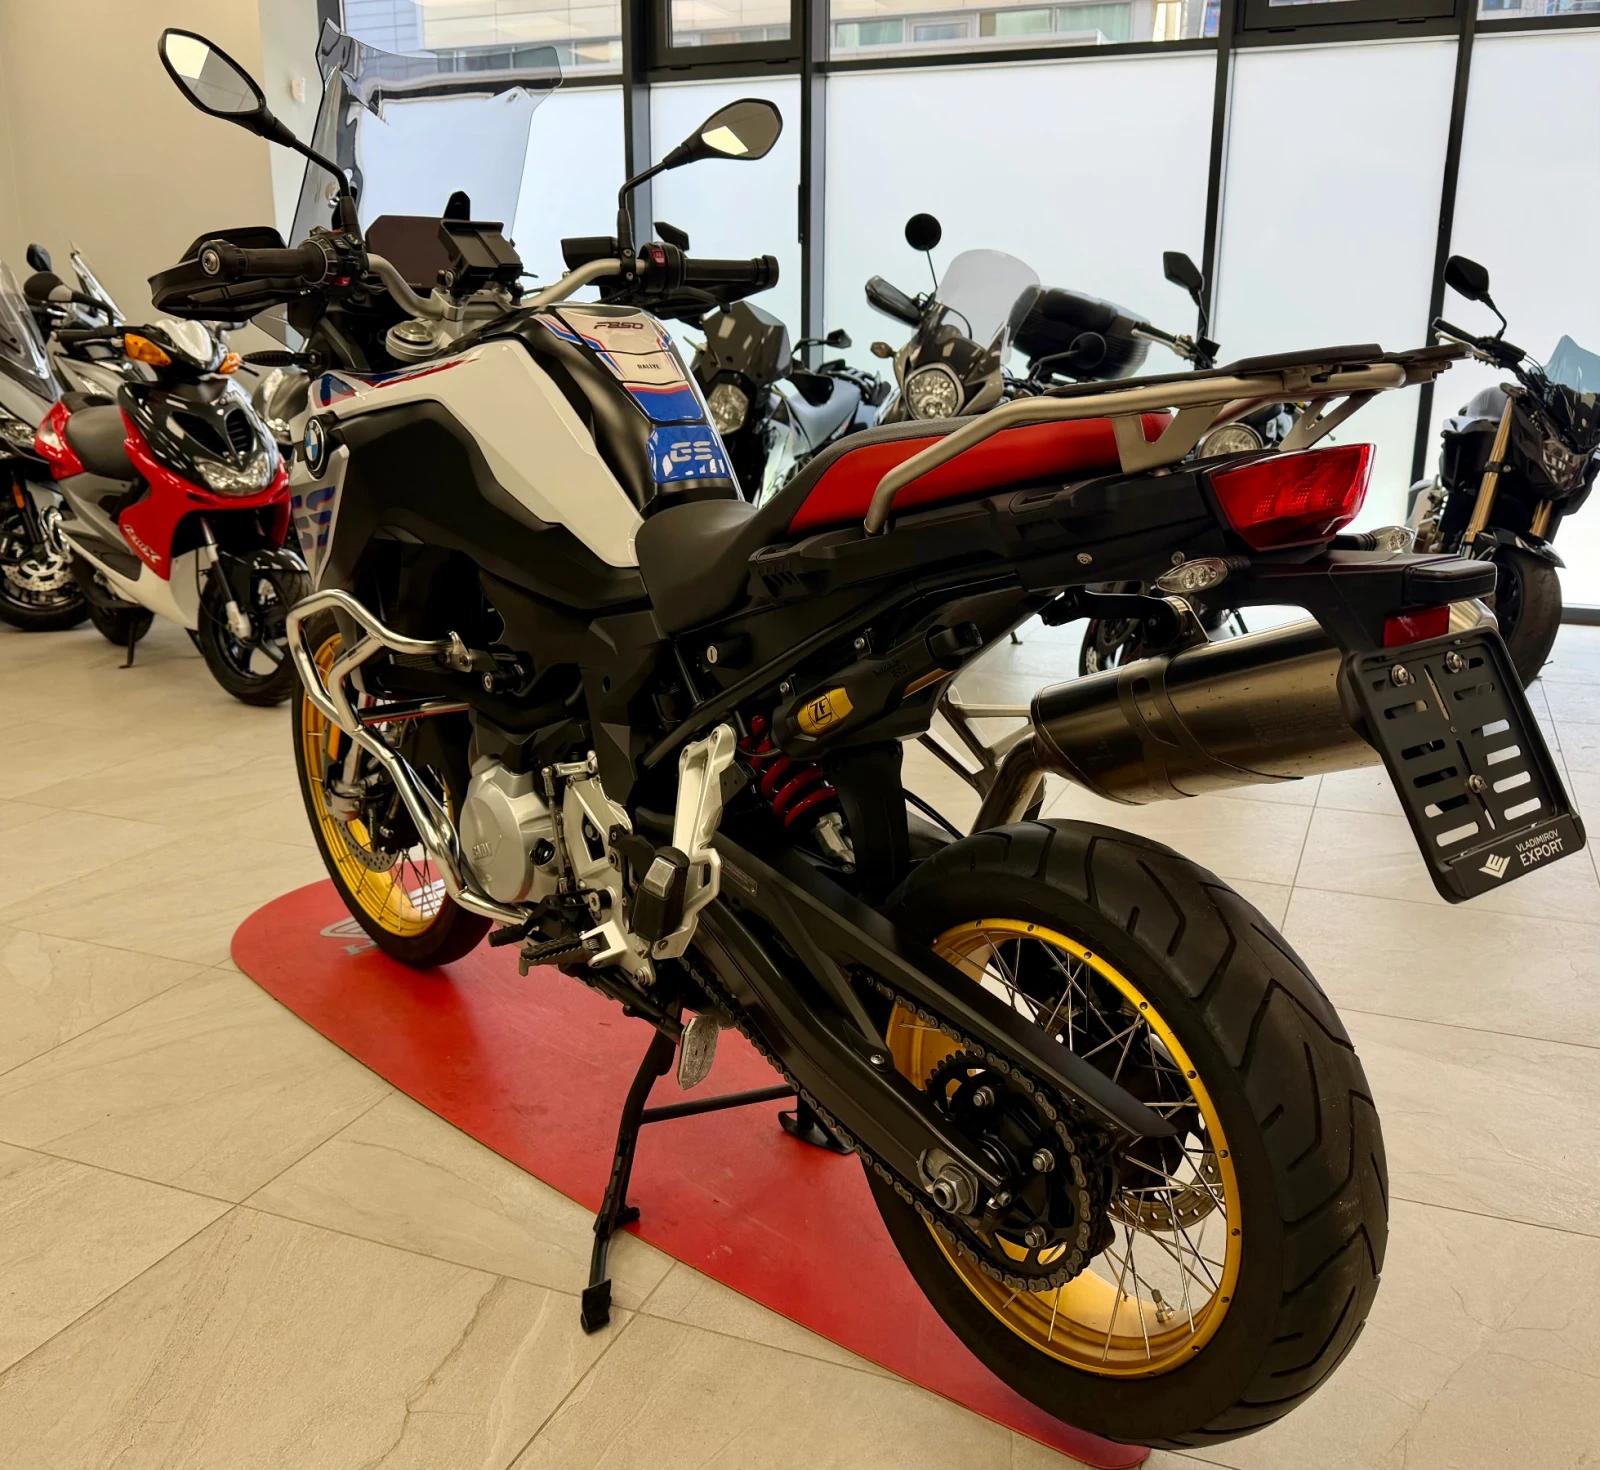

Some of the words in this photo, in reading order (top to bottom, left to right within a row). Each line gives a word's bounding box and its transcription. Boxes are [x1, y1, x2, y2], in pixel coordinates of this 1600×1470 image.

[593, 321, 644, 330] F850
[669, 441, 713, 463] GS
[810, 698, 833, 723] ZF
[1516, 828, 1560, 852] VLADIMIROV
[1519, 838, 1564, 867] EXPORT
